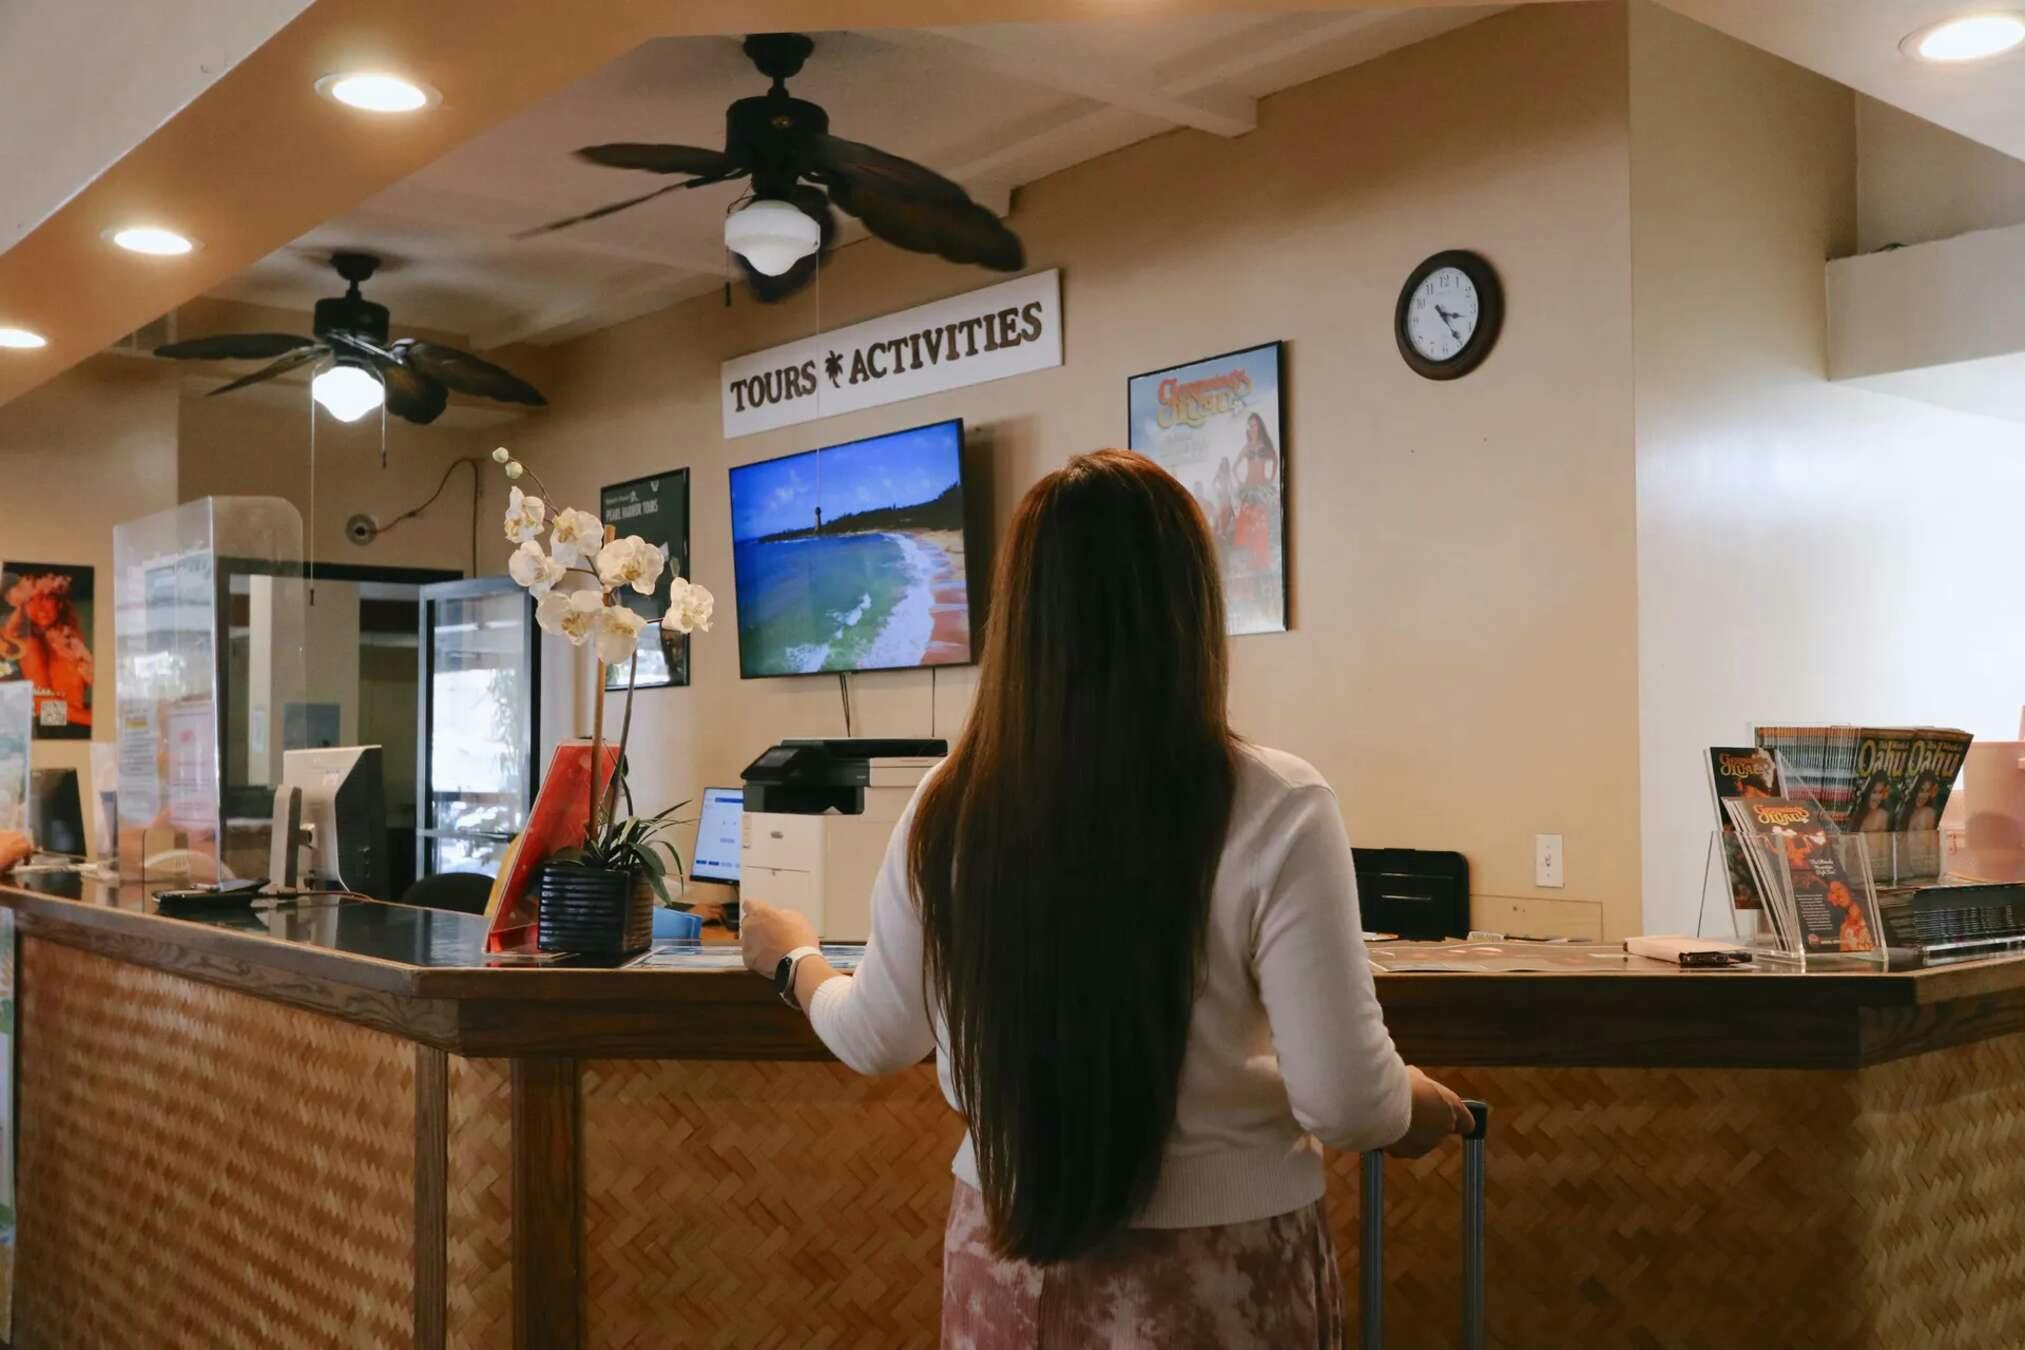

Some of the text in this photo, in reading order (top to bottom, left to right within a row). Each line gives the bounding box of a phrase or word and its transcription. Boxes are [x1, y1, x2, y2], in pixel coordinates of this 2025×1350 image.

[729, 300, 1044, 413] TOURS ACTIVITIES
[1858, 738, 1961, 778] Oahu Oahu
